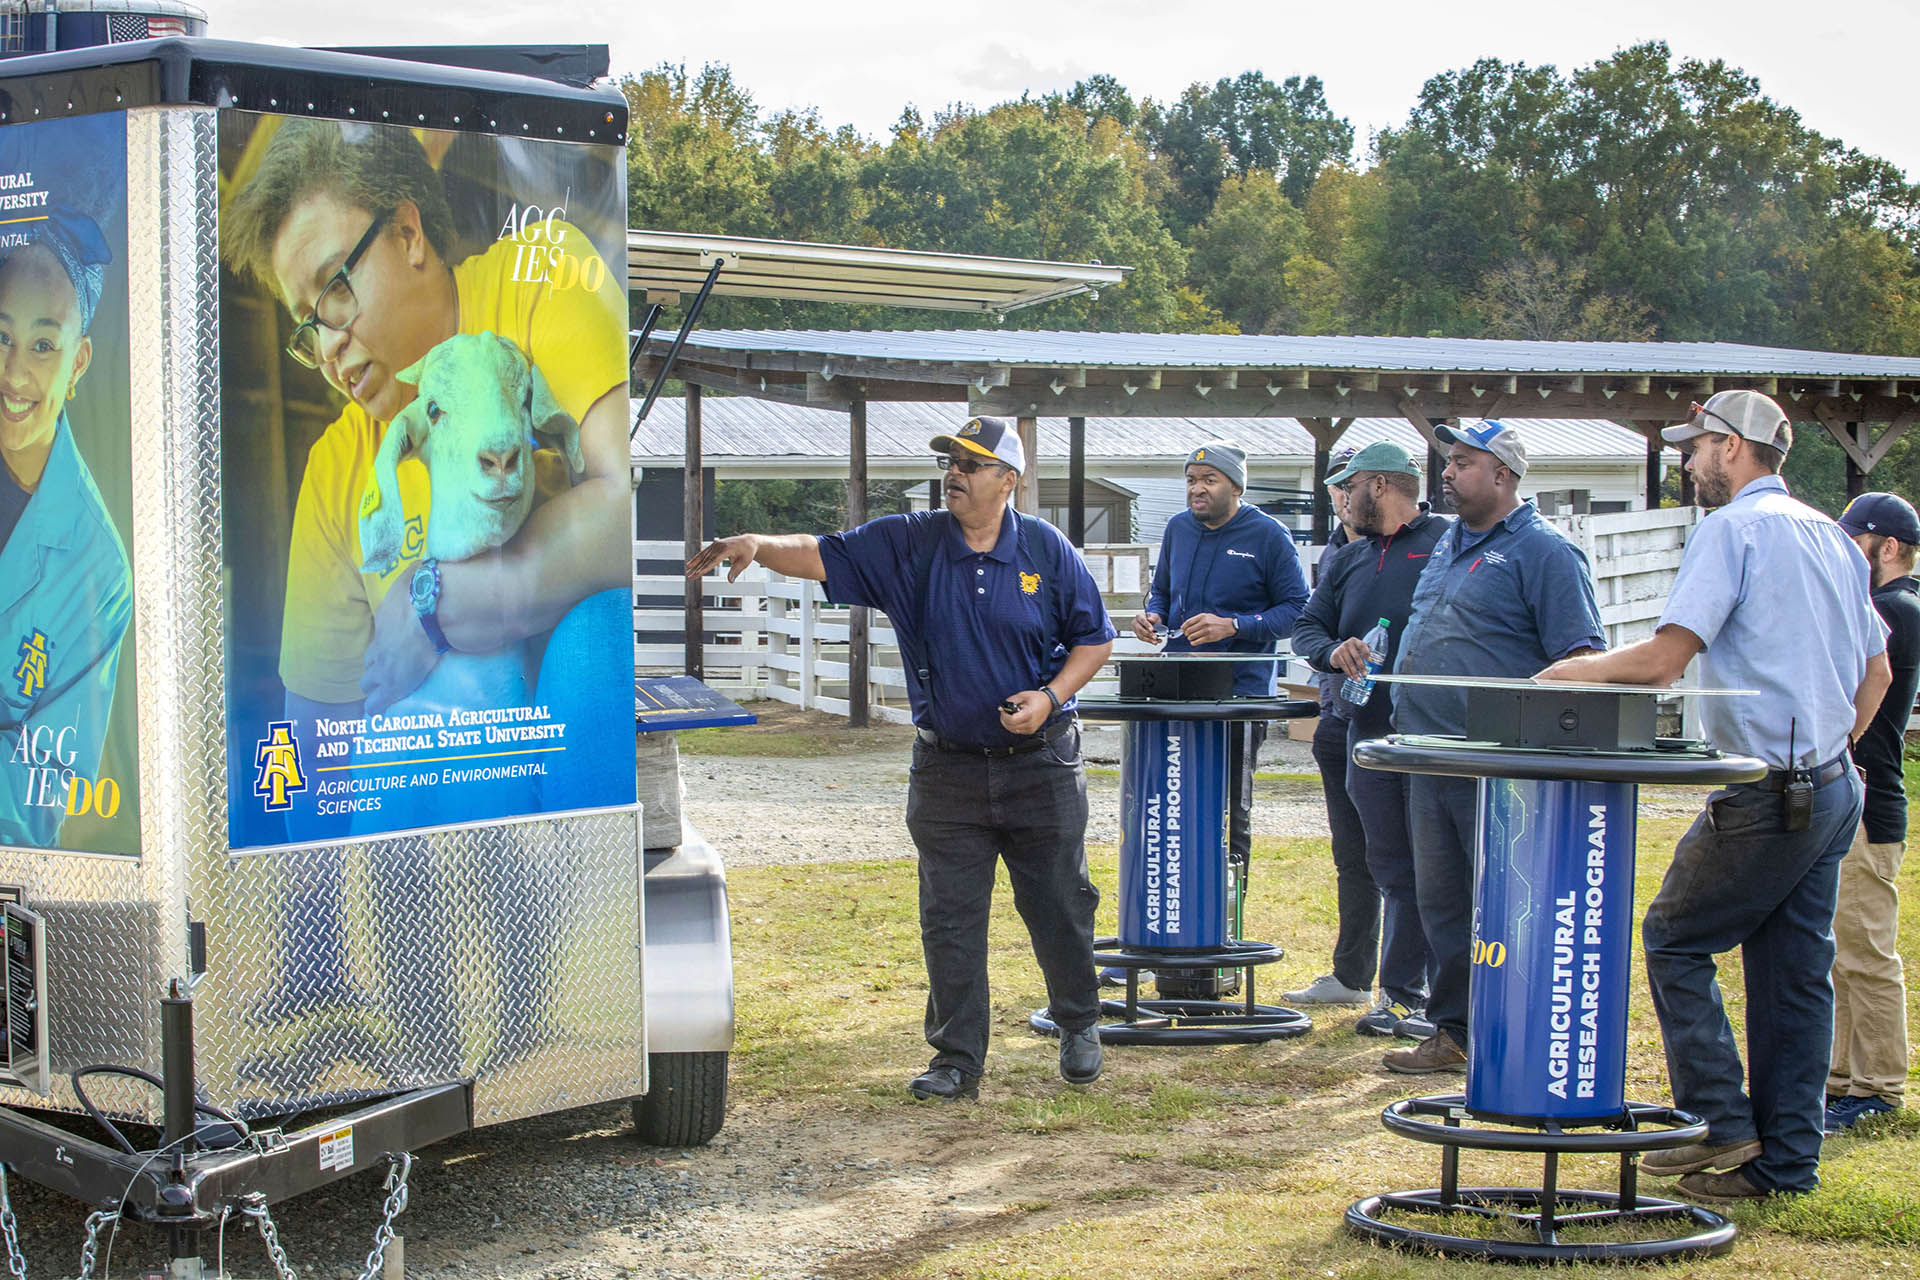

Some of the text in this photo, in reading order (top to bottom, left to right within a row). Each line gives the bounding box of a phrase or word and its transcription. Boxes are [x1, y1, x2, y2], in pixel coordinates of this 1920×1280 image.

[315, 705, 550, 737] NORTH CAROLINA AGRICULTURAL
[316, 723, 566, 758] AND TECHNICAL STATE UNIVERSITY
[9, 723, 79, 767] AGG
[65, 776, 120, 818] DO
[316, 762, 548, 796] AGRICULTURE AND ENVIRONMENTAL
[316, 797, 381, 816] SCIENCES
[1166, 735, 1181, 935] RESEARCH PROGRAM
[1146, 793, 1161, 935] AGRICULTURAL
[1577, 804, 1607, 1098] RESEARCH PROGRAM
[1548, 890, 1576, 1100] AGRICULTURAL
